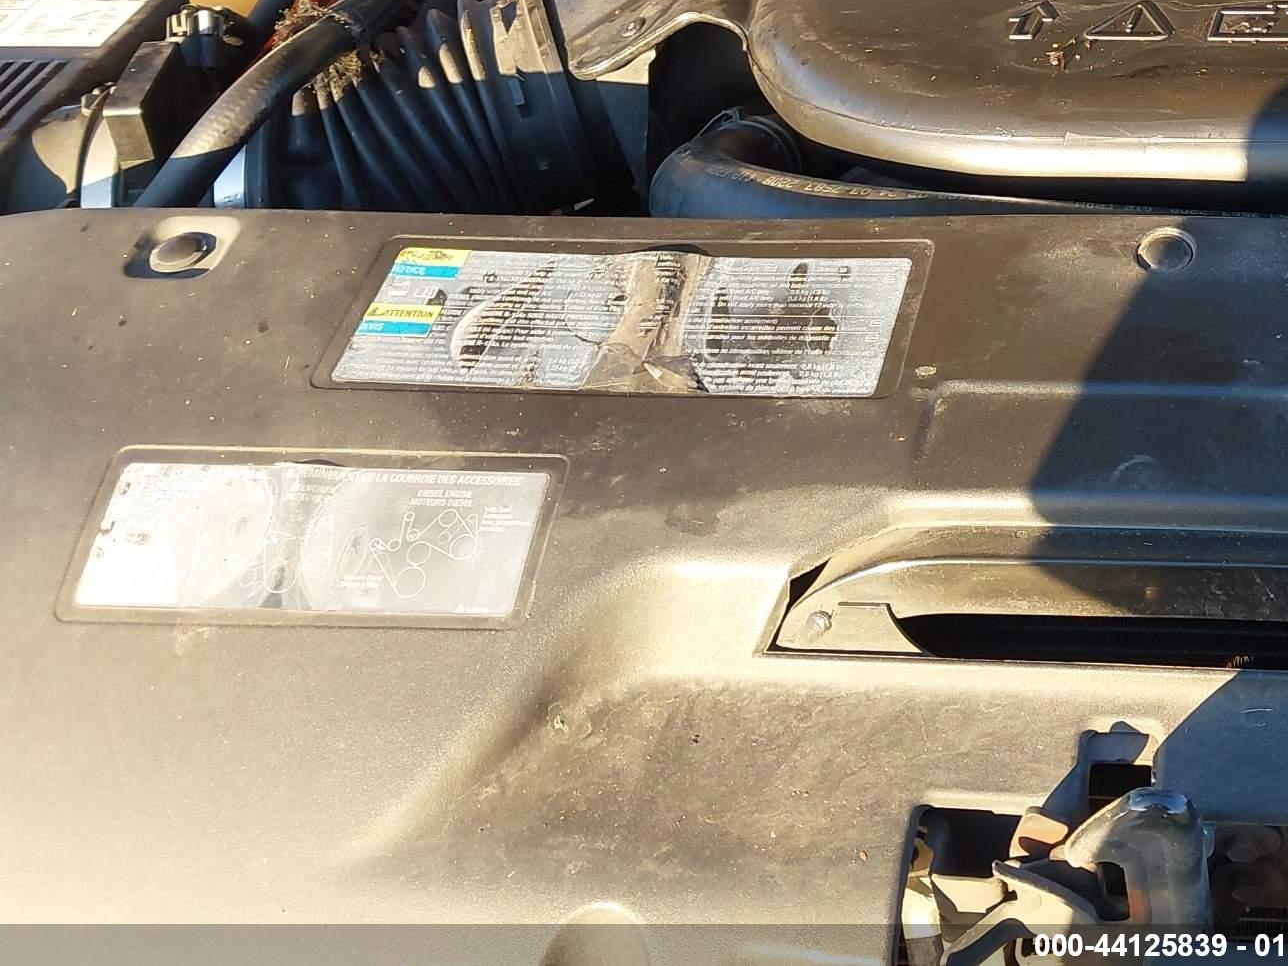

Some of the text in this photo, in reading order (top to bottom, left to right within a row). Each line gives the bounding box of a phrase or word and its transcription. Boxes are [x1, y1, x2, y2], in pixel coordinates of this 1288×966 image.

[383, 308, 434, 319] ATTENTION
[390, 473, 438, 484] COURROIE
[438, 475, 457, 484] DES
